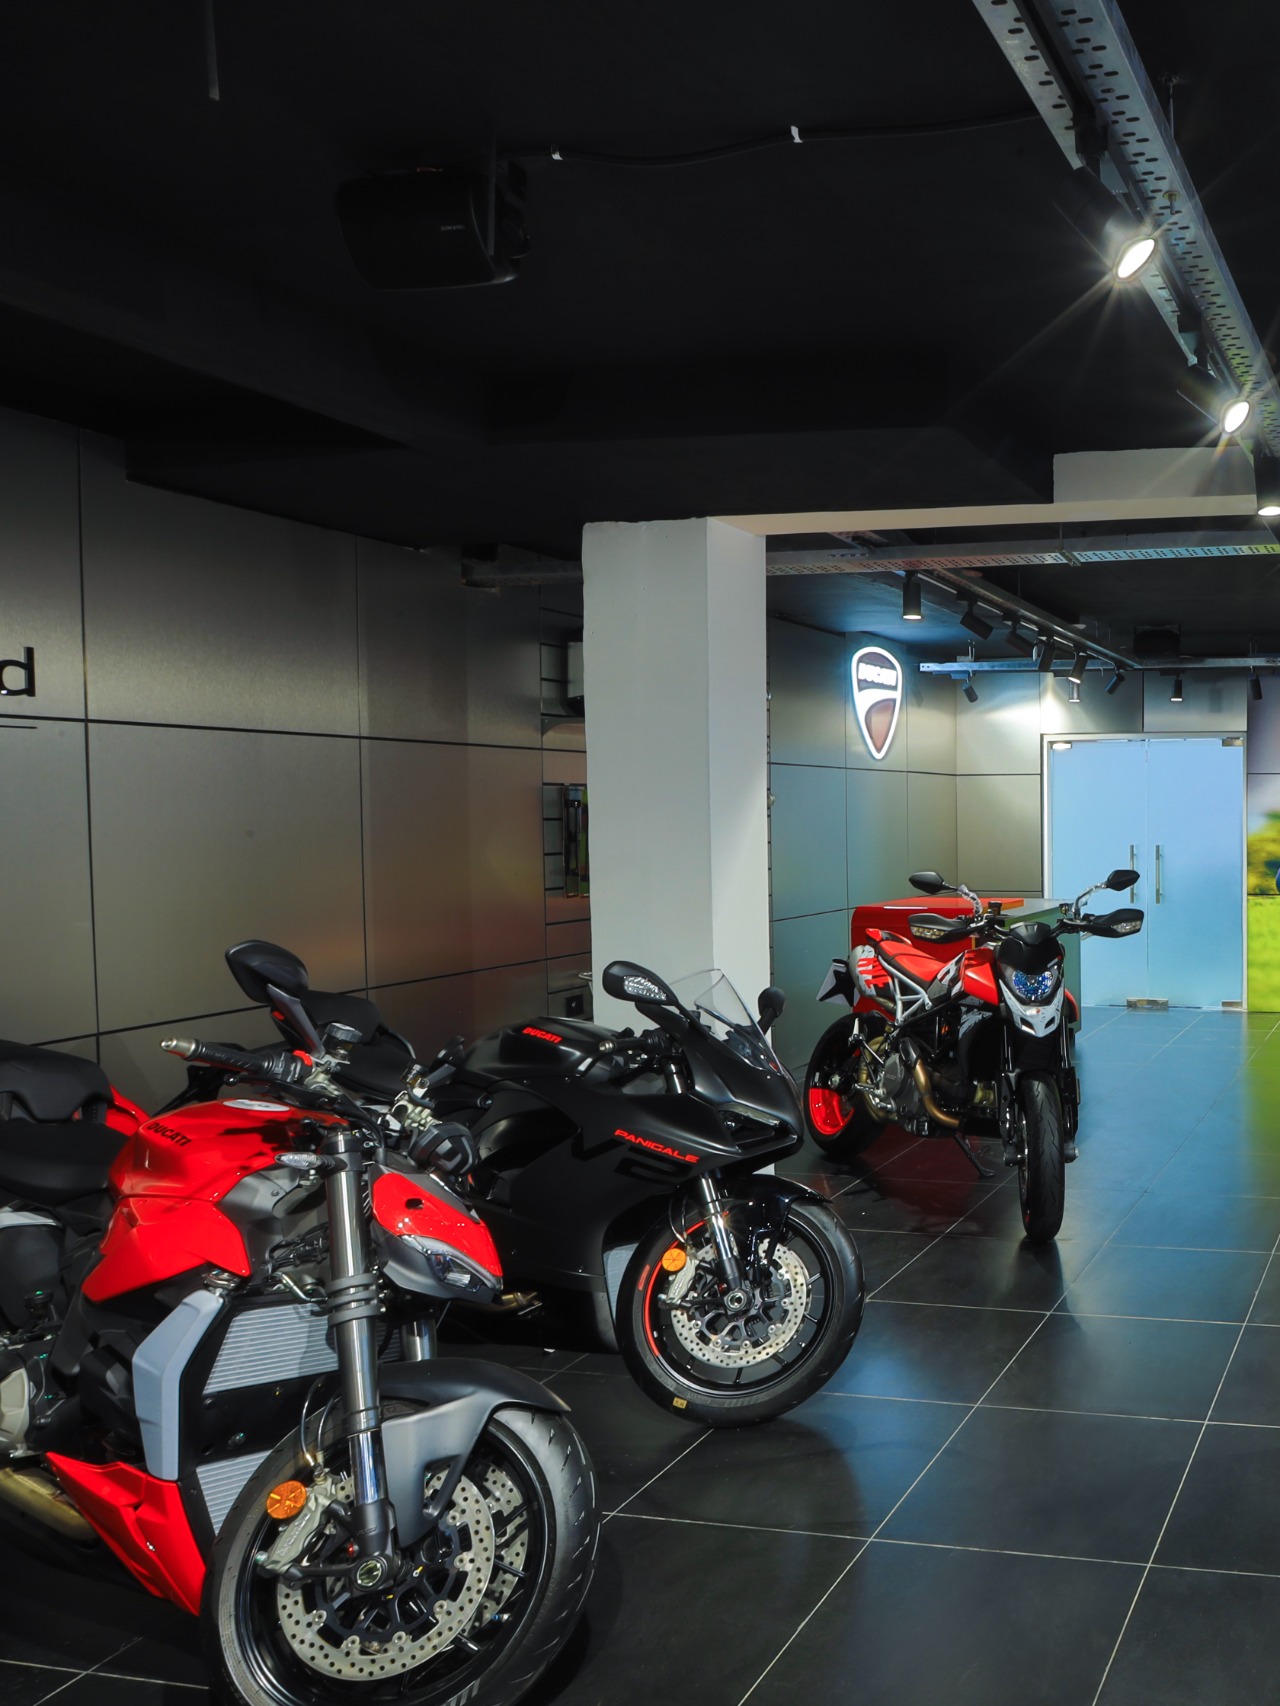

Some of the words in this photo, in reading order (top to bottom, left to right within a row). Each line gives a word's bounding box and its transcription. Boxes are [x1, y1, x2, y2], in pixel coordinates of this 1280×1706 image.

[522, 1027, 562, 1043] DUCATI
[146, 1122, 192, 1147] DUCATI
[614, 1129, 699, 1163] PANIGALE
